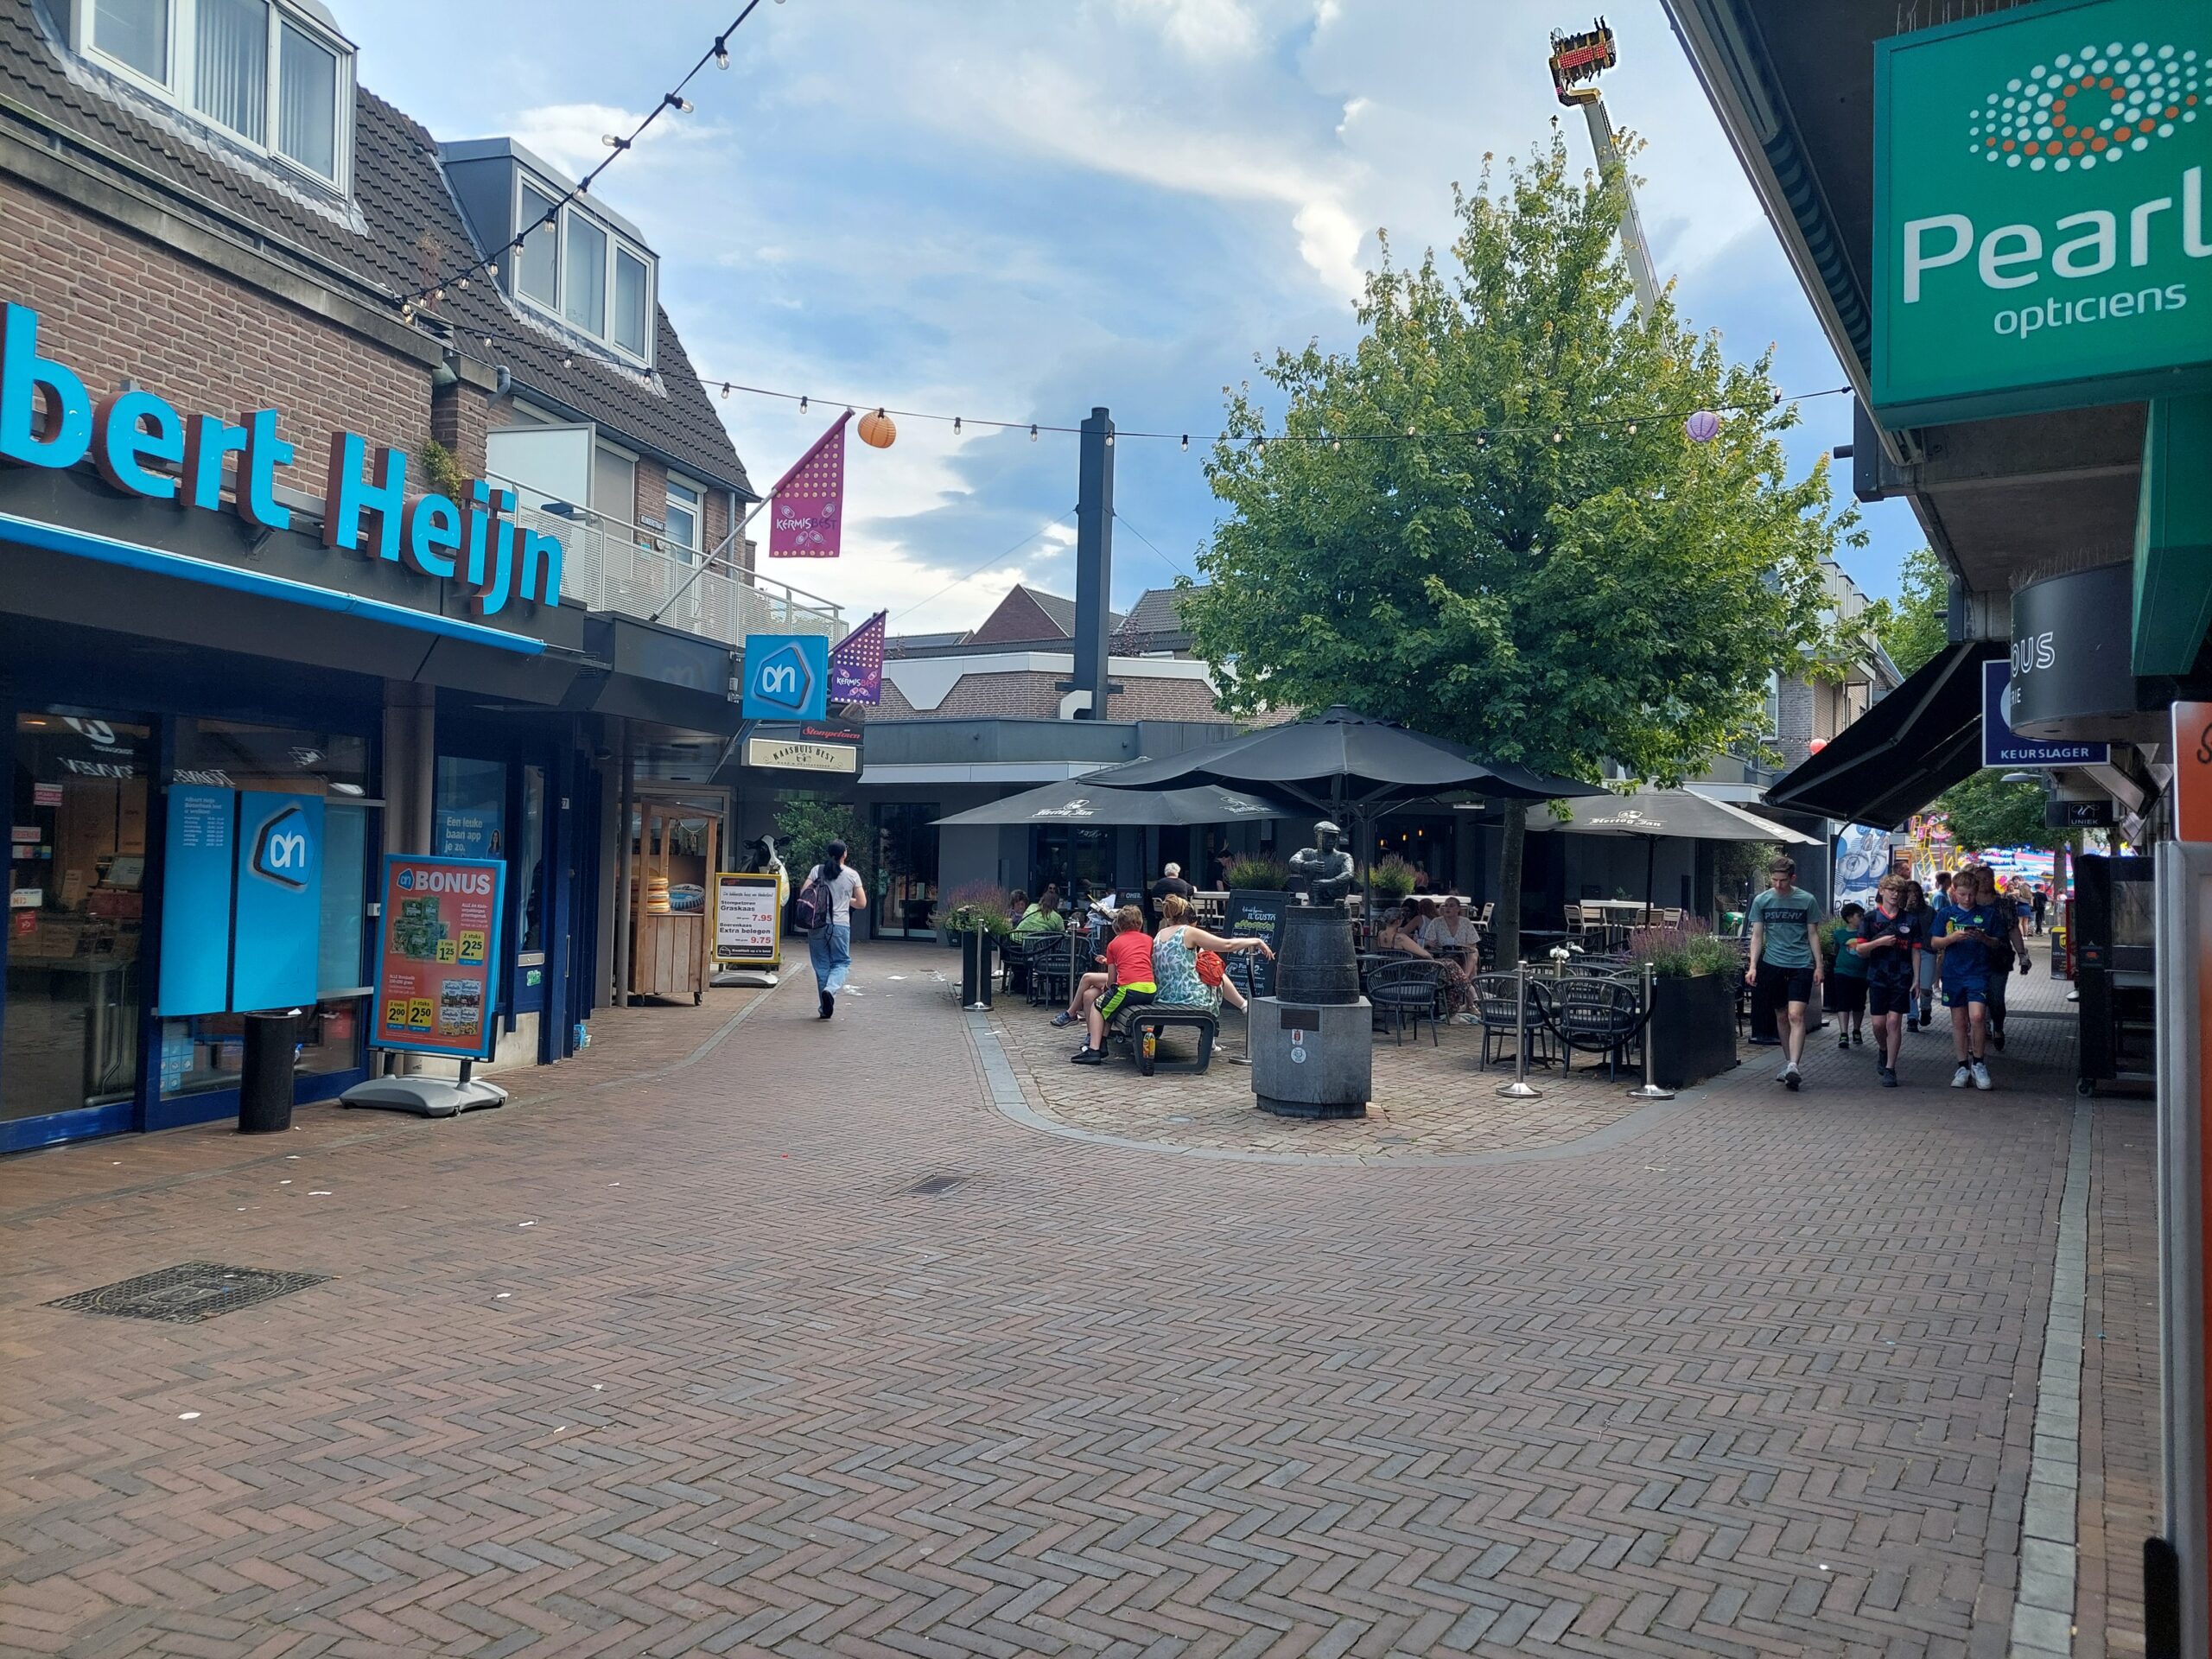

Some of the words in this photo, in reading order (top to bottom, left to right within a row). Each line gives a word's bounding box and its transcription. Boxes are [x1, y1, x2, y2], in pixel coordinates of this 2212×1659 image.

[1903, 165, 2212, 304] Pearl
[1993, 283, 2188, 340] opticiens
[323, 431, 563, 615] Heijn
[772, 745, 813, 761] KAASHUIS
[816, 747, 836, 763] BEST
[2000, 747, 2089, 760] KEURSLAGER
[447, 817, 461, 827] Een
[463, 817, 483, 829] leuke
[446, 829, 465, 839] baan
[467, 832, 481, 842] app
[444, 841, 453, 853] je
[415, 871, 491, 895] BONUS
